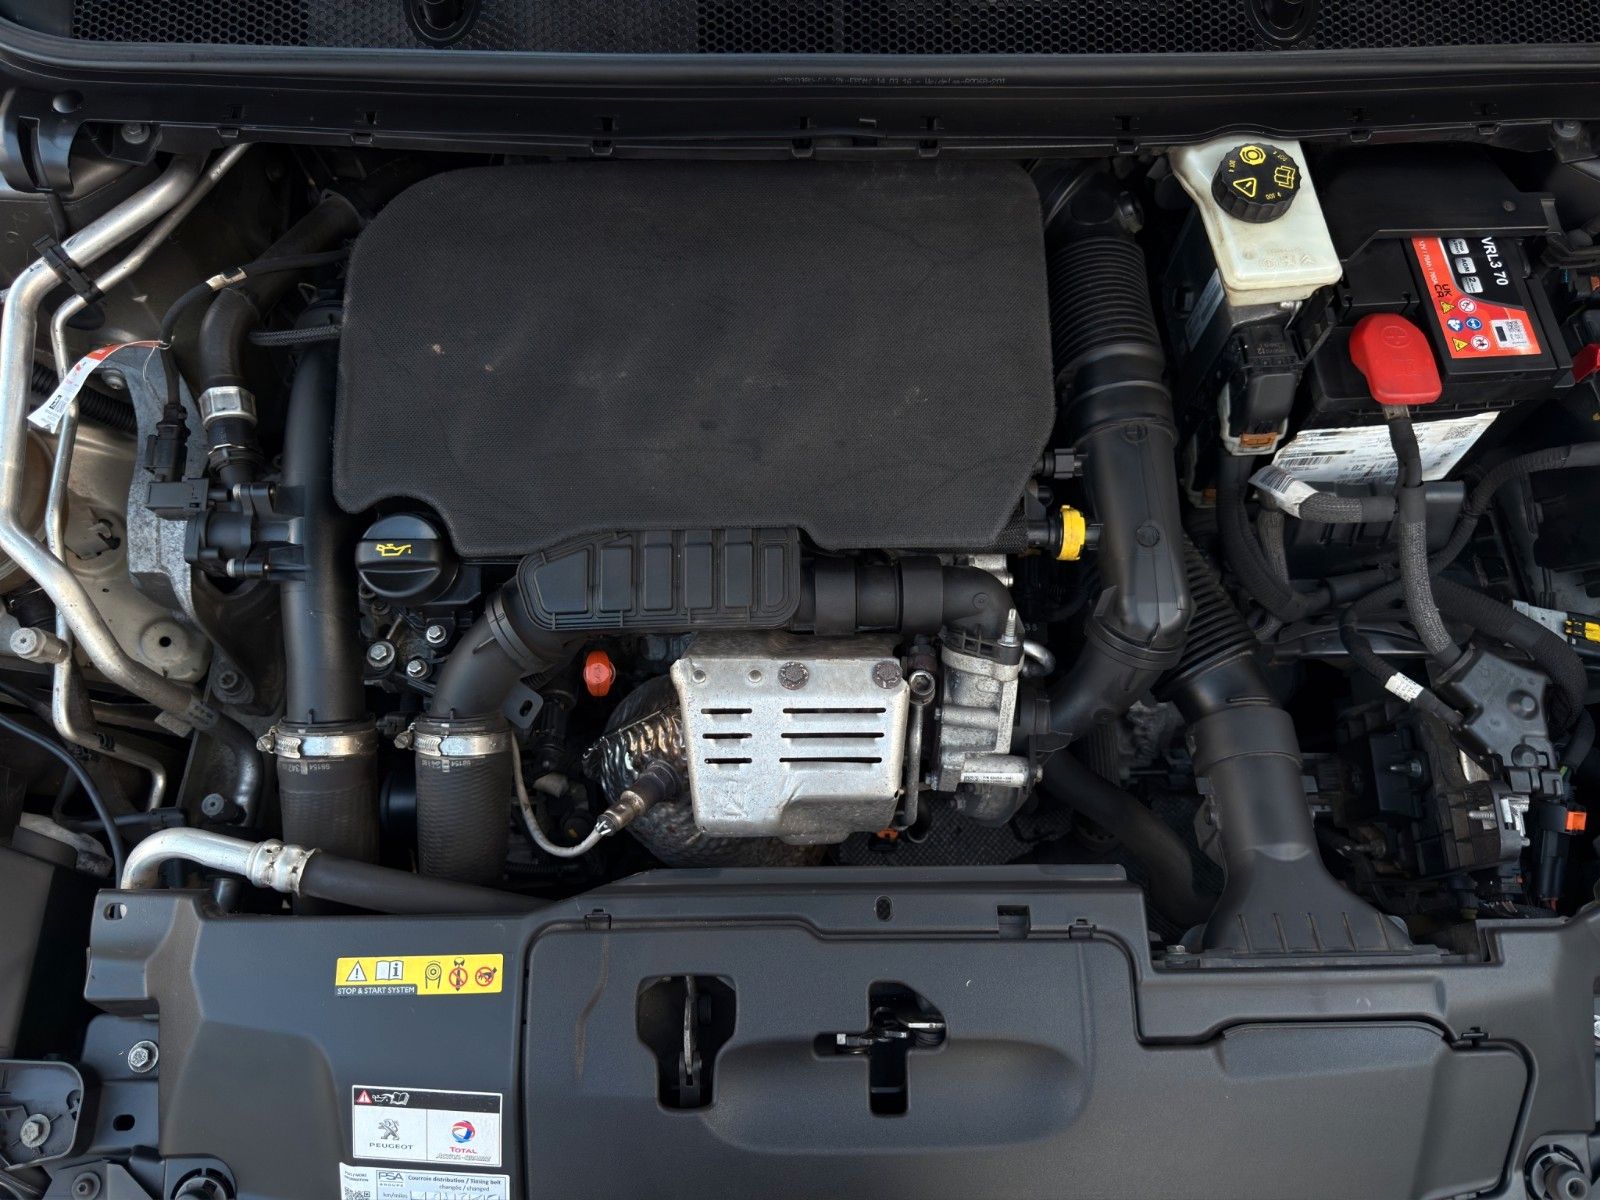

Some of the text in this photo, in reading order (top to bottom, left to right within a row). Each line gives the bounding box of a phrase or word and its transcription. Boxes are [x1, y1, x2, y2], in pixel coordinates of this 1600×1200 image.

[1481, 236, 1508, 286] VRL3 70
[1442, 284, 1452, 296] UK
[449, 1146, 478, 1154] TOTAL
[378, 1172, 404, 1180] PSA
[432, 1176, 464, 1184] distribution
[470, 1178, 489, 1186] Timing
